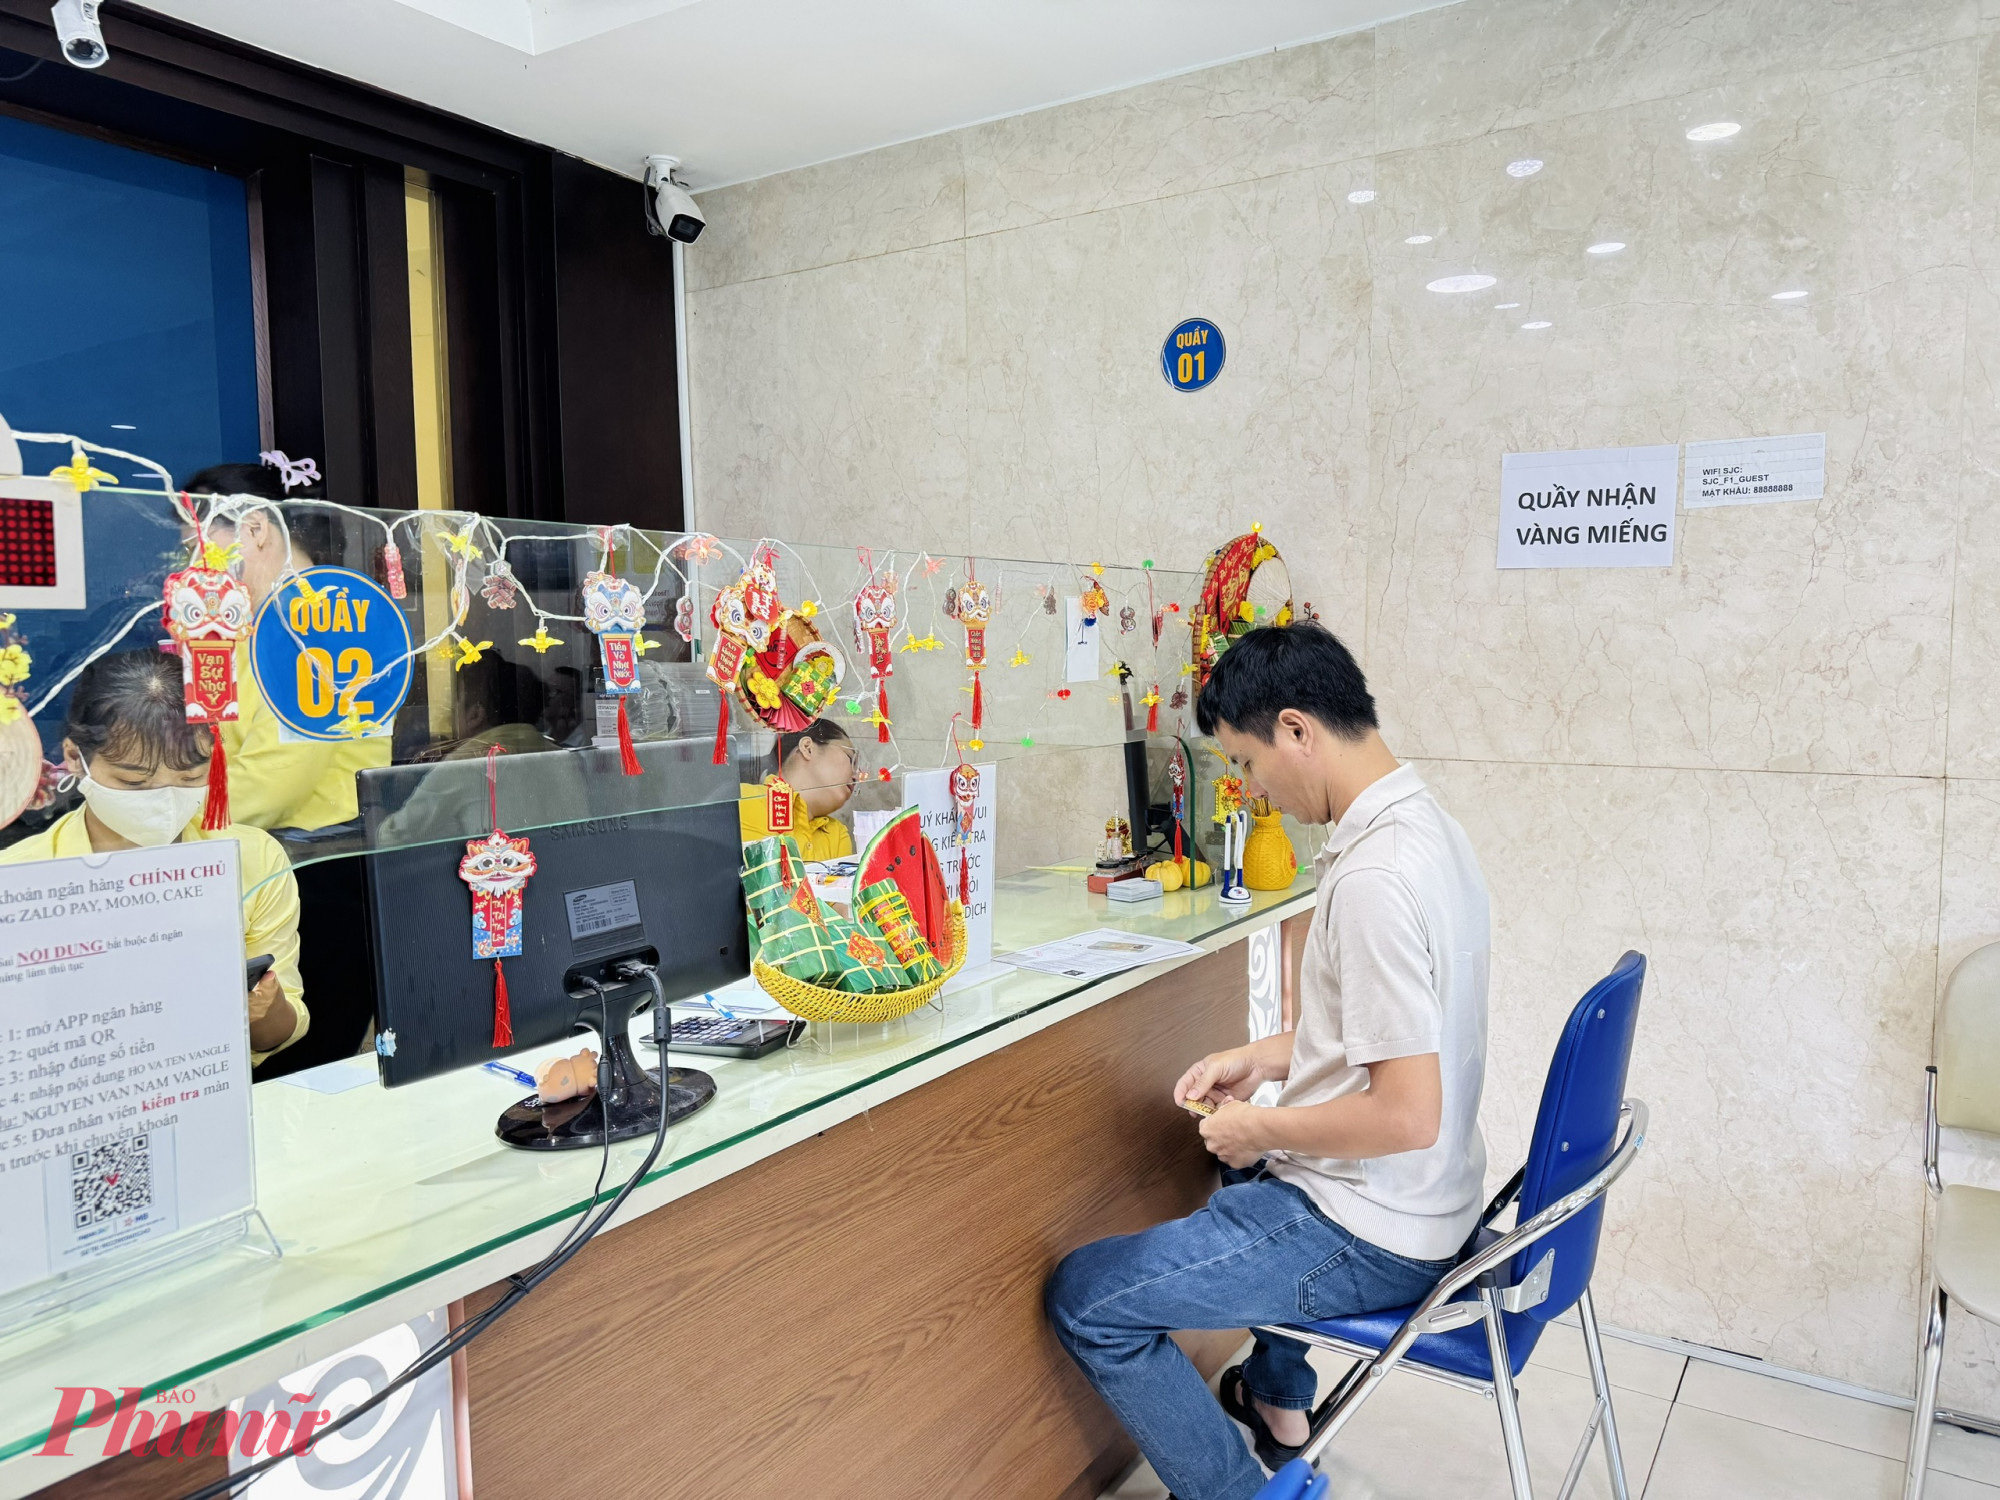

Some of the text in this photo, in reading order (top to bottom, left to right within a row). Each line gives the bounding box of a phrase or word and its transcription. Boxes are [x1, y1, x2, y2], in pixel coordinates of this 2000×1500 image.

[1176, 325, 1209, 350] QUẦY
[1177, 350, 1206, 384] 01
[1702, 466, 1743, 476] WIFI SJC:
[1702, 474, 1770, 486] SJC_F1_GUEST
[1517, 482, 1657, 511] QUẦY NHẬN
[1753, 483, 1794, 494] 88888888
[1516, 517, 1668, 546] VÀNG MIẾNG
[289, 586, 370, 636] QUẦY
[296, 647, 375, 718] 02
[550, 816, 629, 841] SAMSUNG
[920, 810, 933, 828] UÝ
[935, 807, 958, 826] KHÁ
[941, 829, 957, 851] KIỂ
[971, 829, 987, 843] RA
[47, 881, 85, 901] ngân
[129, 867, 186, 887] CHÍNH
[190, 860, 226, 879] CHỦ
[18, 904, 66, 922] ZALO
[69, 899, 102, 915] PAY,
[105, 891, 160, 911] MOMO,
[162, 885, 204, 902] CAKE
[964, 901, 987, 920] DỊCH
[54, 939, 103, 958] DUNG
[8, 1029, 21, 1041] 1:
[54, 1012, 88, 1032] APP
[8, 1049, 22, 1063] 2:
[91, 1028, 117, 1046] QR
[8, 1070, 23, 1085] 3:
[9, 1091, 24, 1104] 4:
[92, 1069, 126, 1085] dung
[188, 1043, 231, 1061] VANGLE
[22, 1093, 94, 1124] NGUYEN
[97, 1085, 130, 1103] VAN
[133, 1075, 169, 1096] NAM
[172, 1060, 230, 1084] VANGLE
[13, 1133, 27, 1148] 5:
[180, 1088, 200, 1101] tra
[54, 1138, 79, 1157] khi
